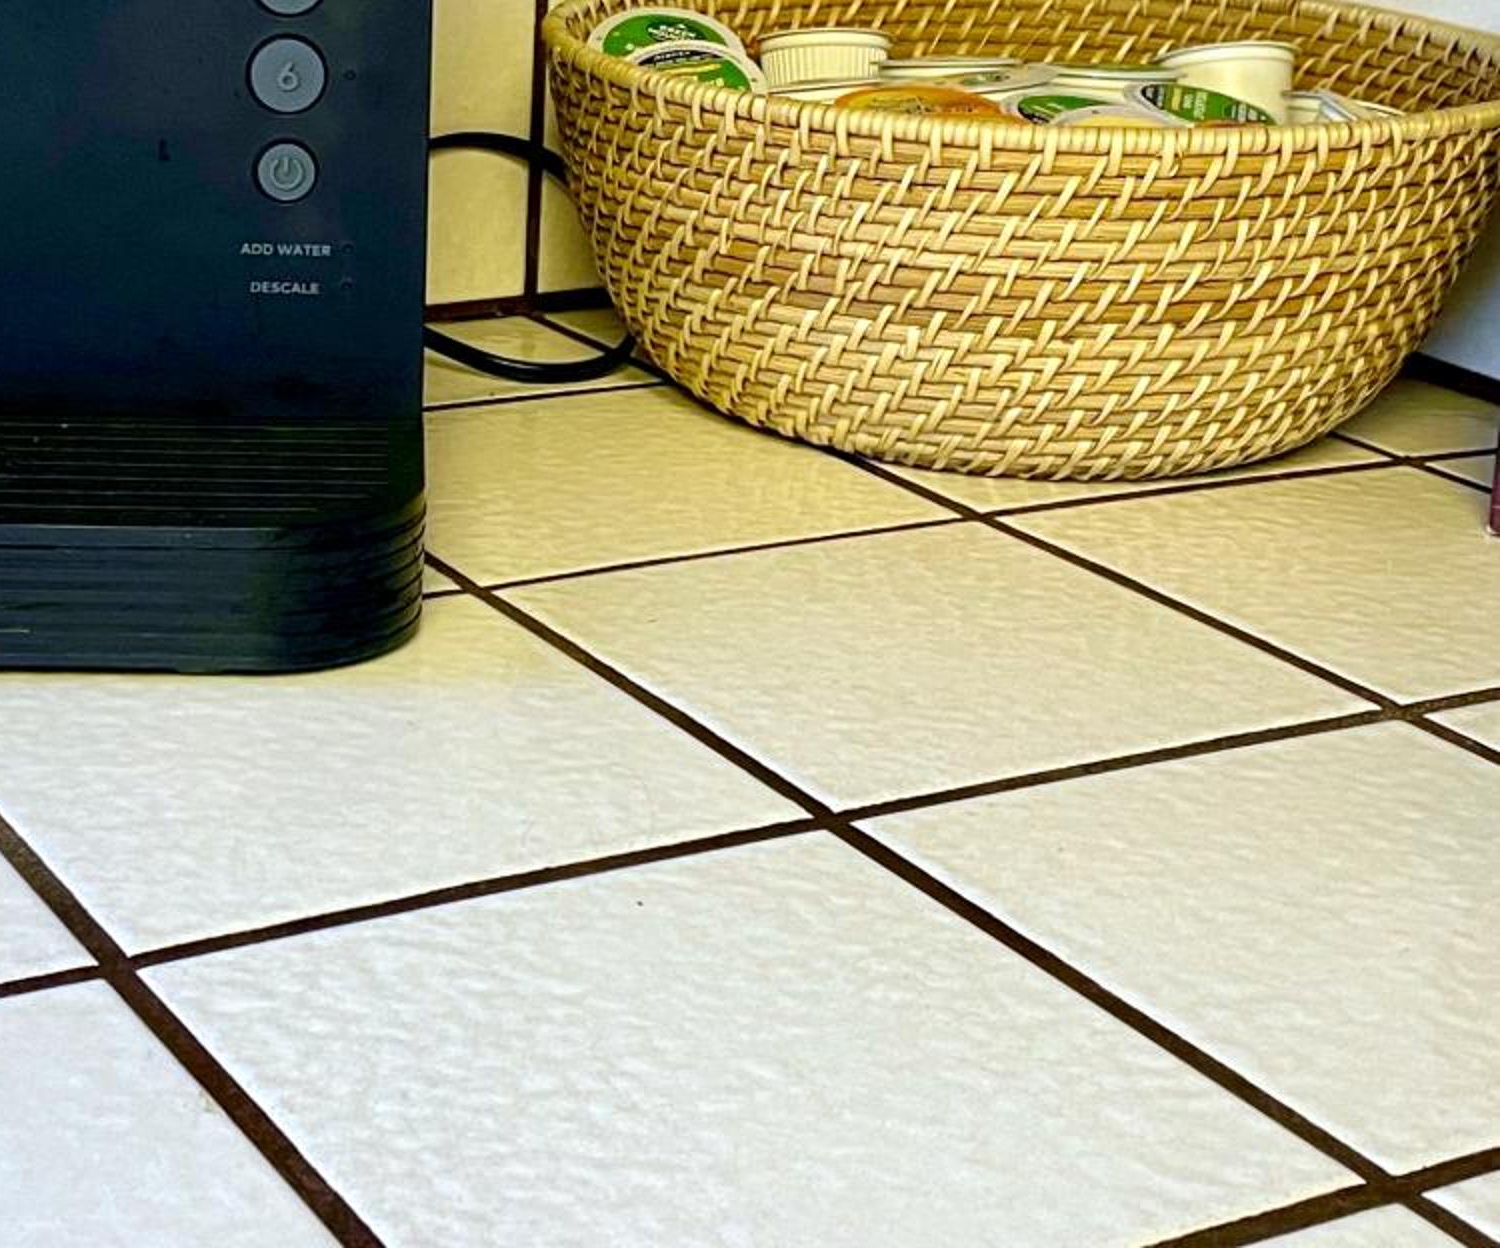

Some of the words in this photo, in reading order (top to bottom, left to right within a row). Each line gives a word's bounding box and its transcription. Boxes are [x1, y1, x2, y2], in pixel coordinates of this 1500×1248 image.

[276, 61, 301, 93] 6
[239, 242, 274, 256] ADD
[276, 243, 332, 258] WATER
[249, 281, 320, 295] DESCALE
